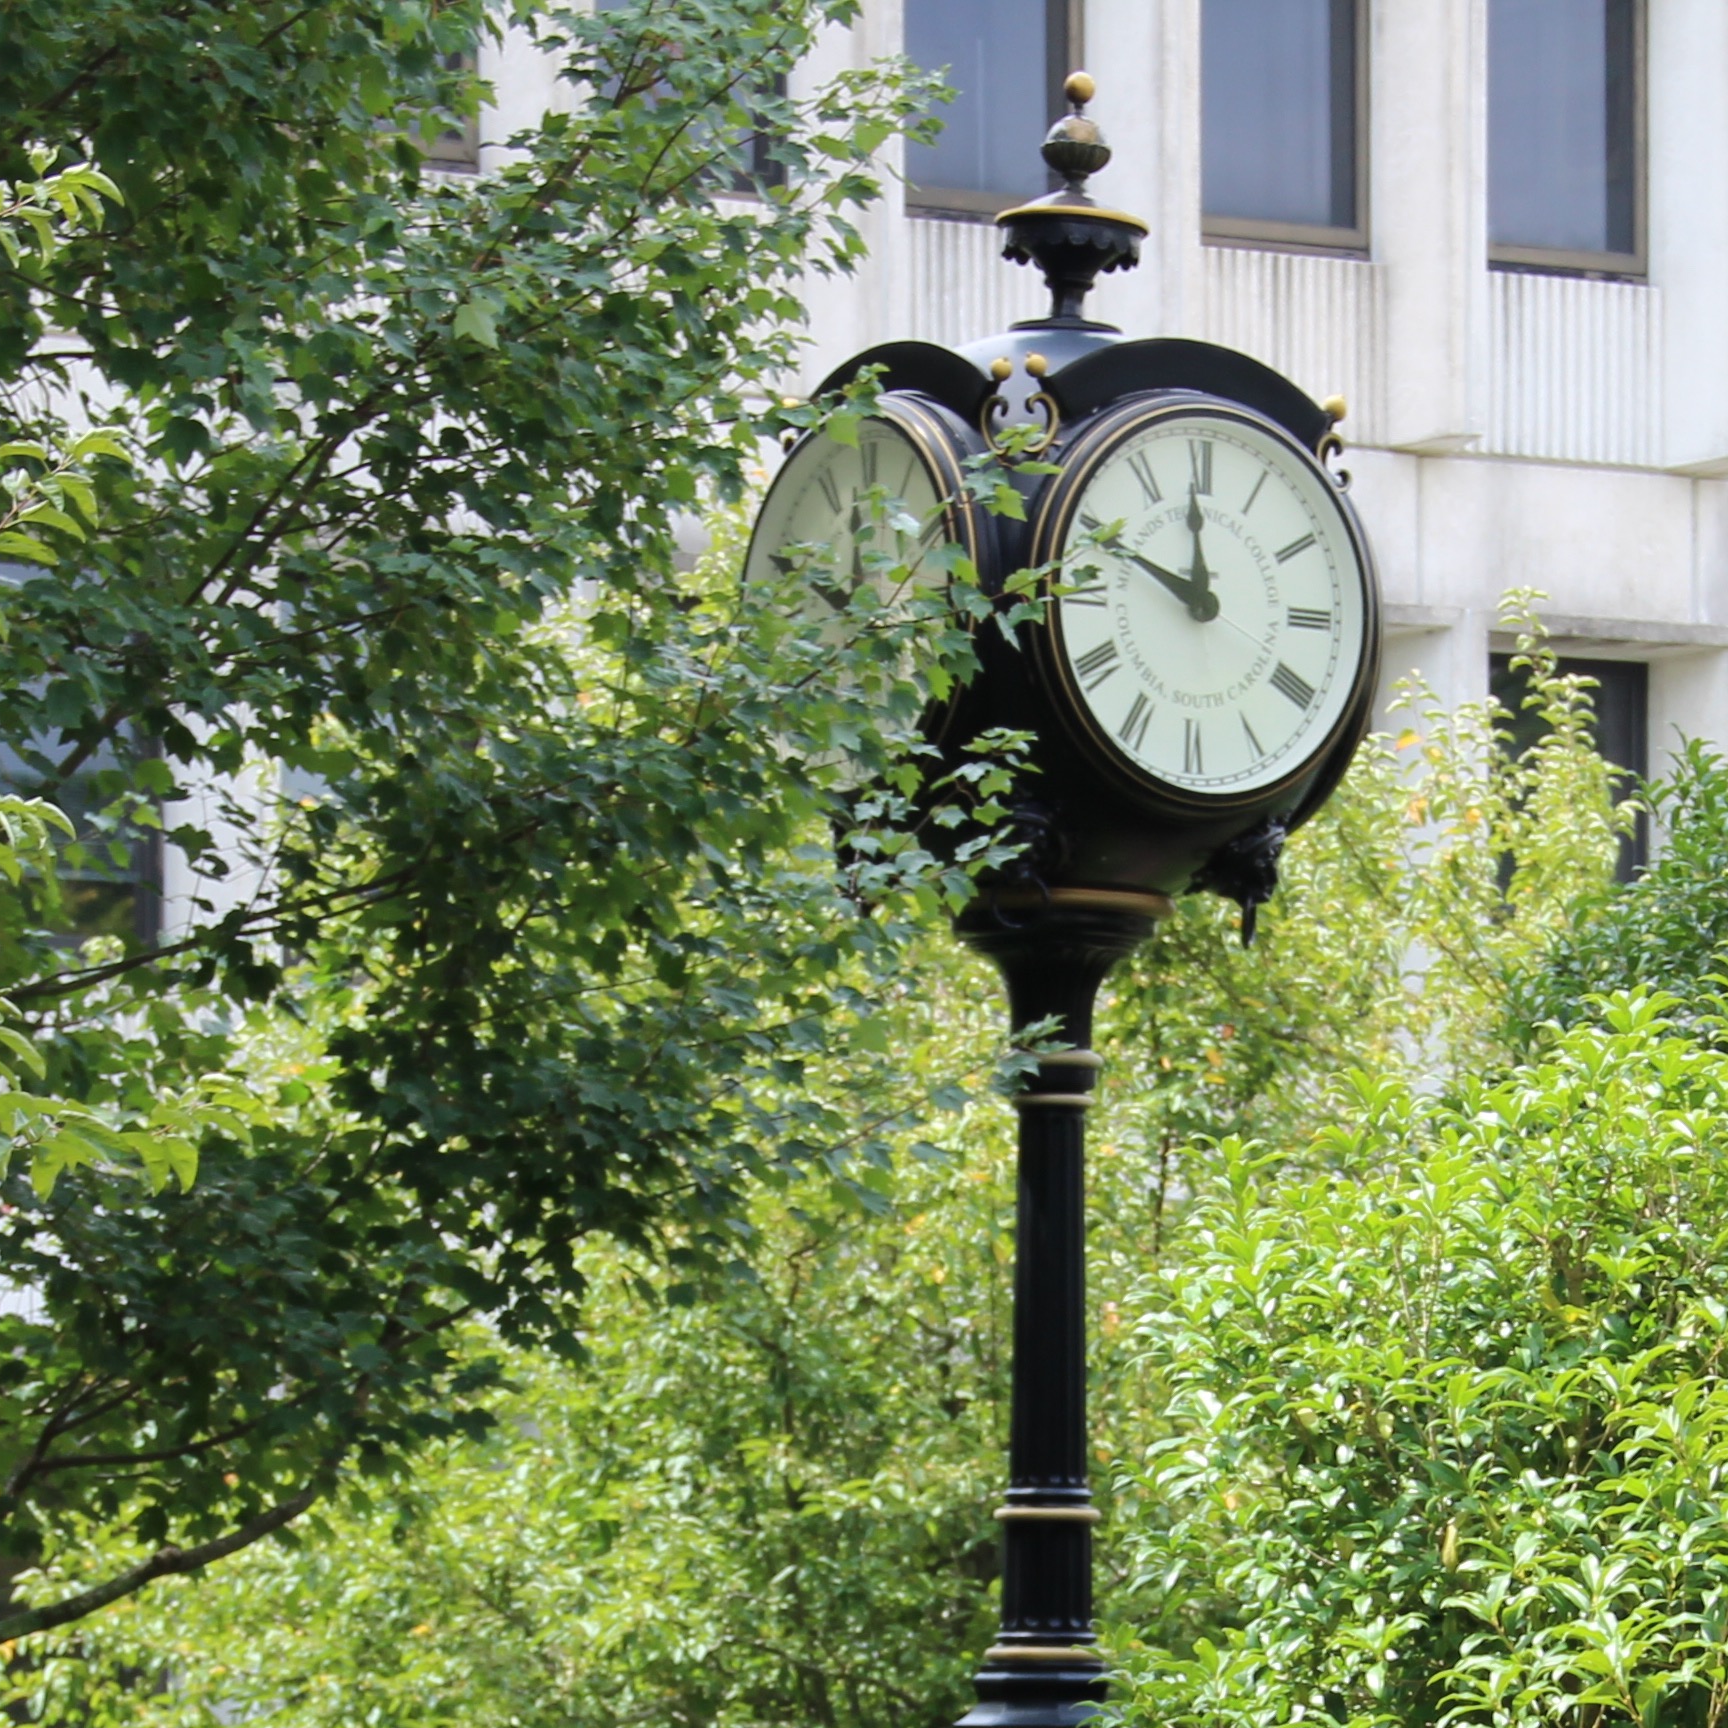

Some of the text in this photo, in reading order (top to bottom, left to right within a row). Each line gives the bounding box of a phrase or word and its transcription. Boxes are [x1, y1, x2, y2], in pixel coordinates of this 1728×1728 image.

[1125, 449, 1164, 512] XI
[1187, 438, 1213, 497] XII
[1115, 513, 1166, 591] MIANDS
[1164, 505, 1244, 540] TENICAL
[1243, 535, 1281, 608] COLLEGE
[1273, 531, 1318, 565] II
[1286, 605, 1332, 632] III
[1074, 639, 1122, 693] VIII
[1114, 602, 1281, 709] COLUMBIA, SOUTH CAROLINA
[1269, 660, 1317, 712] IIII
[1118, 691, 1155, 753] VII
[1182, 717, 1204, 775] VI
[1237, 709, 1266, 763] V
